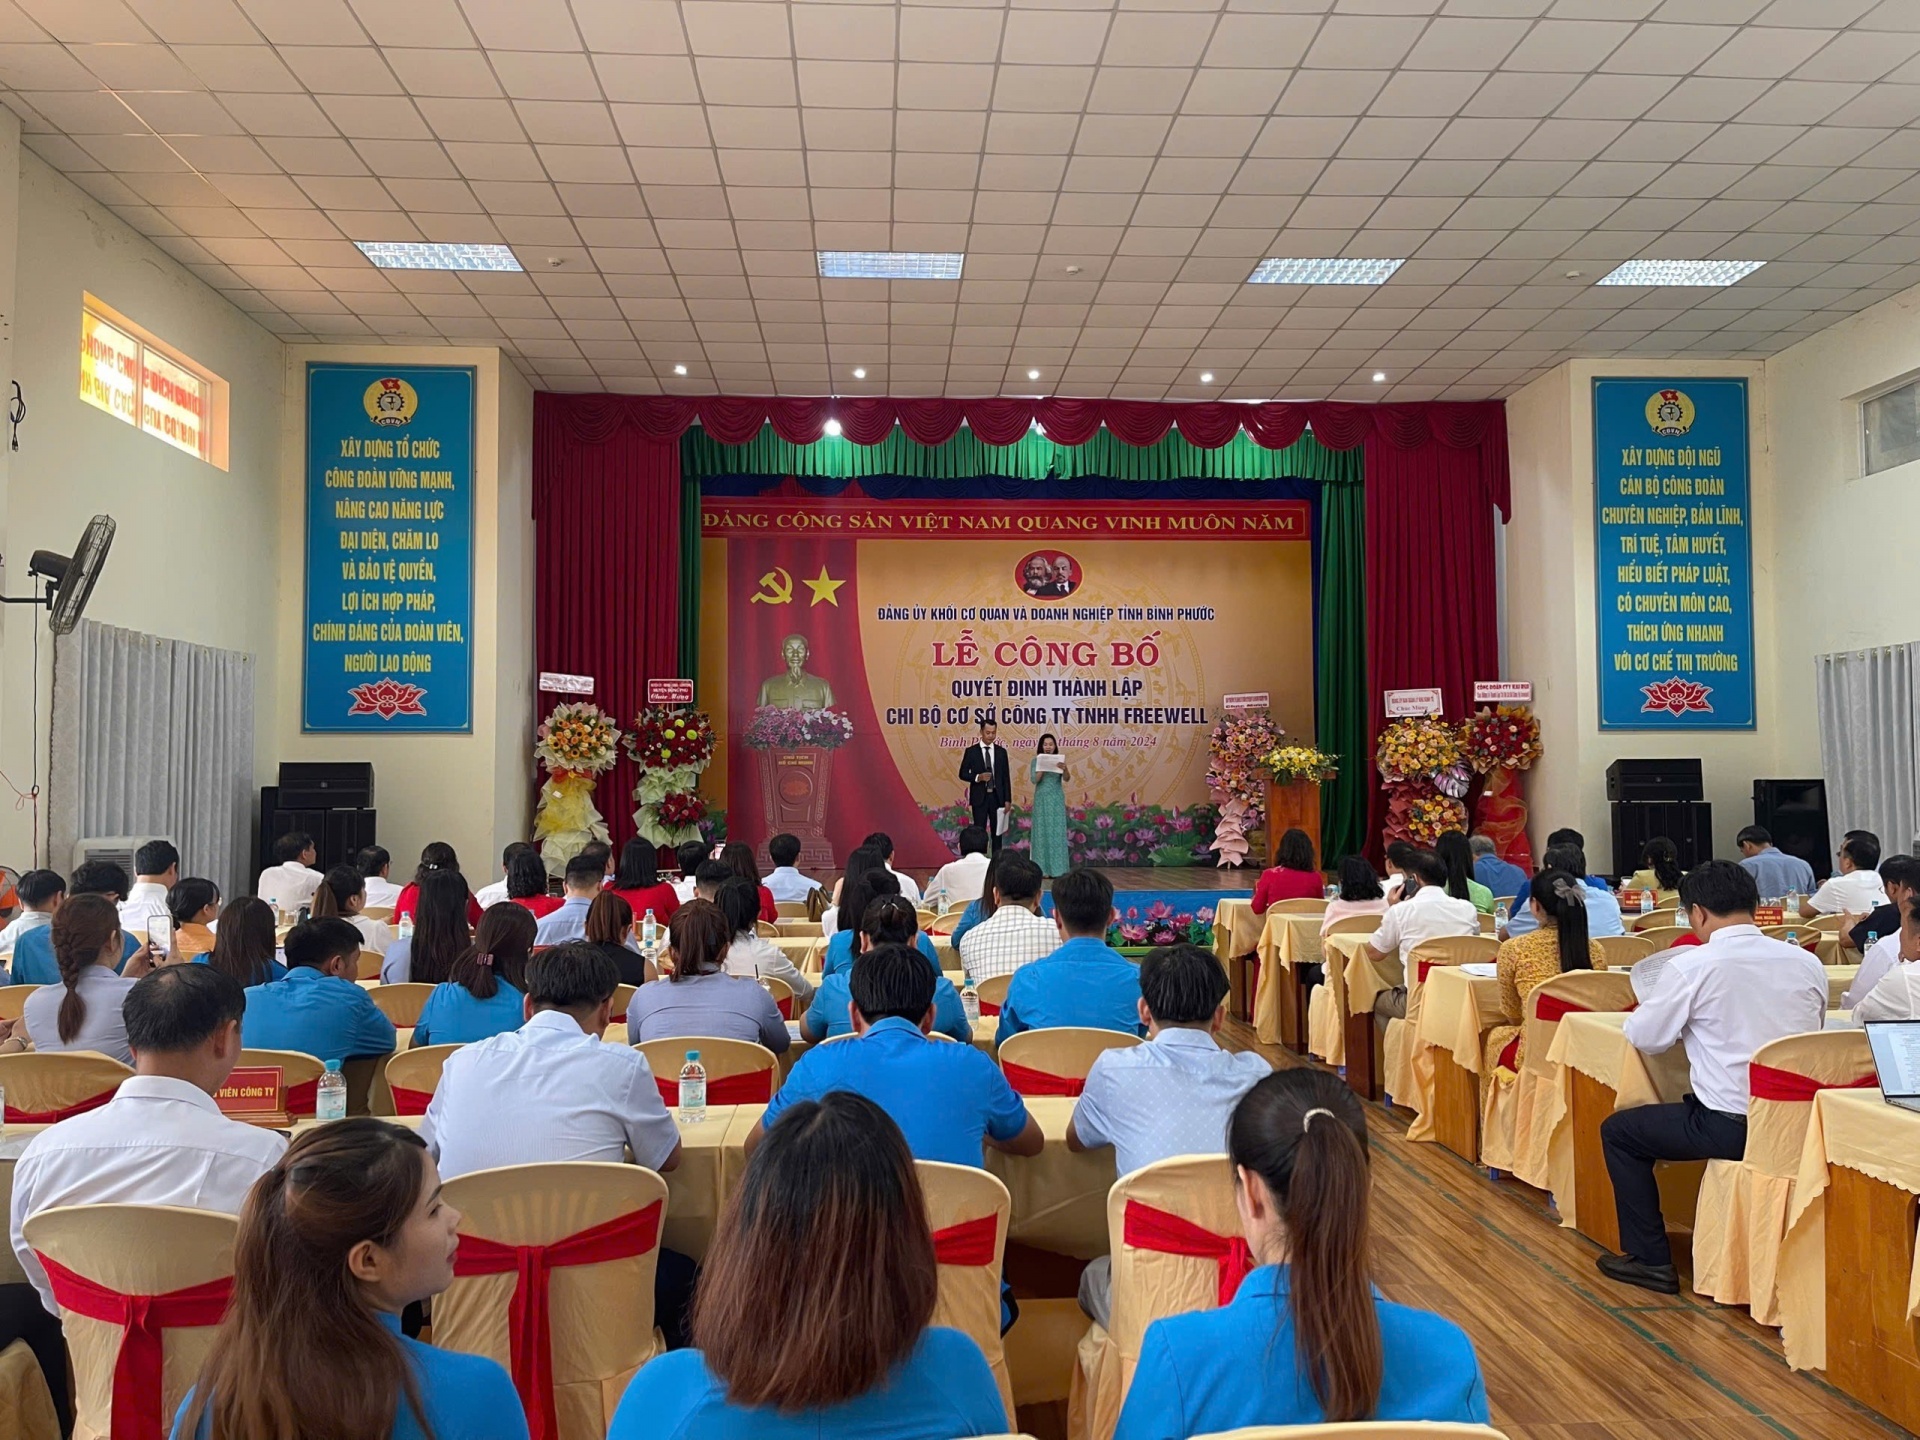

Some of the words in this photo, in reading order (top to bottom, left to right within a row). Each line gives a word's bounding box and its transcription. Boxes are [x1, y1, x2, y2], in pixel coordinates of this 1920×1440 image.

[340, 436, 362, 458] XÂY
[364, 438, 394, 462] DỰNG
[395, 433, 410, 459] TỔ
[411, 437, 440, 459] CHỨC
[1622, 445, 1643, 466] XÂY
[1645, 447, 1675, 470] DỰNG
[1677, 445, 1696, 470] ĐỘI
[1698, 446, 1721, 466] NGŨ
[325, 466, 355, 488] CÔNG
[356, 466, 387, 489] ĐOÀN
[389, 467, 418, 489] VỮNG
[420, 471, 455, 493] MẠNH,
[1620, 474, 1643, 495] CÁN
[1645, 474, 1660, 499] BỘ
[1662, 474, 1692, 495] CÔNG
[1694, 475, 1724, 496] ĐOÀN
[335, 497, 366, 519] NÂNG
[367, 500, 390, 520] CAO
[391, 498, 422, 520] NĂNG
[424, 499, 445, 523] LỰC
[703, 509, 769, 527] ĐẢNG
[776, 511, 842, 531] CỘNG
[849, 511, 893, 529] SẢN
[900, 512, 952, 532] VIỆT
[959, 515, 1011, 530] NAM
[1017, 515, 1098, 532] QUANG
[1105, 516, 1161, 530] VINH
[1168, 513, 1236, 530] MUÔN
[1243, 514, 1294, 530] NĂM
[1602, 503, 1645, 525] CHUYÊN
[1647, 503, 1688, 528] NGHIỆP,
[1690, 501, 1714, 525] BẢN
[1716, 504, 1743, 527] LĨNH,
[340, 531, 359, 553] ĐẠI
[361, 527, 389, 554] DIỆN,
[391, 528, 424, 550] CHĂM
[425, 531, 439, 550] LO
[1620, 533, 1638, 554] TRÍ
[1639, 533, 1663, 557] TUỆ,
[1665, 533, 1689, 554] TÂM
[1691, 532, 1727, 555] HUYẾT,
[342, 558, 356, 580] VÀ
[358, 556, 381, 580] BẢO
[382, 558, 396, 584] VỆ
[398, 556, 437, 583] QUYỀN,
[1617, 559, 1643, 583] HIỂU
[1645, 560, 1669, 583] BIẾT
[1671, 562, 1700, 583] PHÁP
[1703, 562, 1730, 587] LUẬT,
[342, 591, 359, 615] LỢI
[361, 589, 380, 611] ÍCH
[382, 591, 404, 615] HỢP
[406, 589, 436, 613] PHÁP,
[877, 603, 909, 621] ĐẢNG
[912, 603, 927, 621] ỦY
[930, 605, 957, 621] KHỐI
[961, 606, 976, 621] CƠ
[979, 608, 1010, 622] QUAN
[1012, 605, 1028, 621] VÀ
[1030, 608, 1069, 621] DOANH
[1072, 605, 1114, 624] NGHIỆP
[1117, 603, 1143, 621] TỈNH
[1146, 605, 1174, 621] BÌNH
[1177, 605, 1215, 621] PHƯỚC
[1617, 591, 1633, 613] CÓ
[1634, 591, 1678, 613] CHUYÊN
[1680, 591, 1706, 613] MÔN
[1708, 595, 1732, 614] CAO,
[313, 620, 346, 642] CHÍNH
[348, 620, 378, 642] ĐÁNG
[380, 617, 403, 642] CỦA
[404, 620, 434, 642] ĐOÀN
[436, 620, 464, 644] VIÊN,
[1626, 620, 1659, 642] THÍCH
[1661, 621, 1684, 642] ỨNG
[1686, 624, 1724, 642] NHANH
[932, 629, 980, 667] LỄ
[994, 635, 1098, 667] CÔNG
[1110, 630, 1161, 667] BỐ
[344, 650, 377, 673] NGƯỜI
[380, 654, 400, 673] LAO
[402, 650, 432, 676] ĐỘNG
[1614, 650, 1632, 671] VỚI
[1634, 652, 1650, 671] CƠ
[1652, 648, 1674, 671] CHẾ
[1675, 653, 1693, 675] THỊ
[1695, 650, 1738, 672] TRƯỜNG
[951, 674, 1003, 699] QUYẾT
[1007, 679, 1048, 701] ĐỊNH
[1052, 676, 1107, 697] THÀNH
[1112, 676, 1143, 700] LẬP
[886, 707, 914, 725] CHI
[919, 704, 941, 729] BỘ
[947, 706, 969, 725] CƠ
[1001, 704, 1047, 725] CÔNG
[1051, 707, 1071, 724] TY
[1075, 707, 1119, 724] TNHH
[1124, 707, 1209, 724] FREEWELL
[940, 735, 967, 748] Bình
[1012, 736, 1038, 751] ngày
[1058, 736, 1090, 748] tháng
[1093, 736, 1100, 747] 8
[1103, 736, 1126, 747] năm
[1131, 736, 1157, 747] 2024
[220, 1086, 239, 1098] VIÊN
[240, 1086, 263, 1098] CÔNG
[264, 1086, 275, 1097] TY
